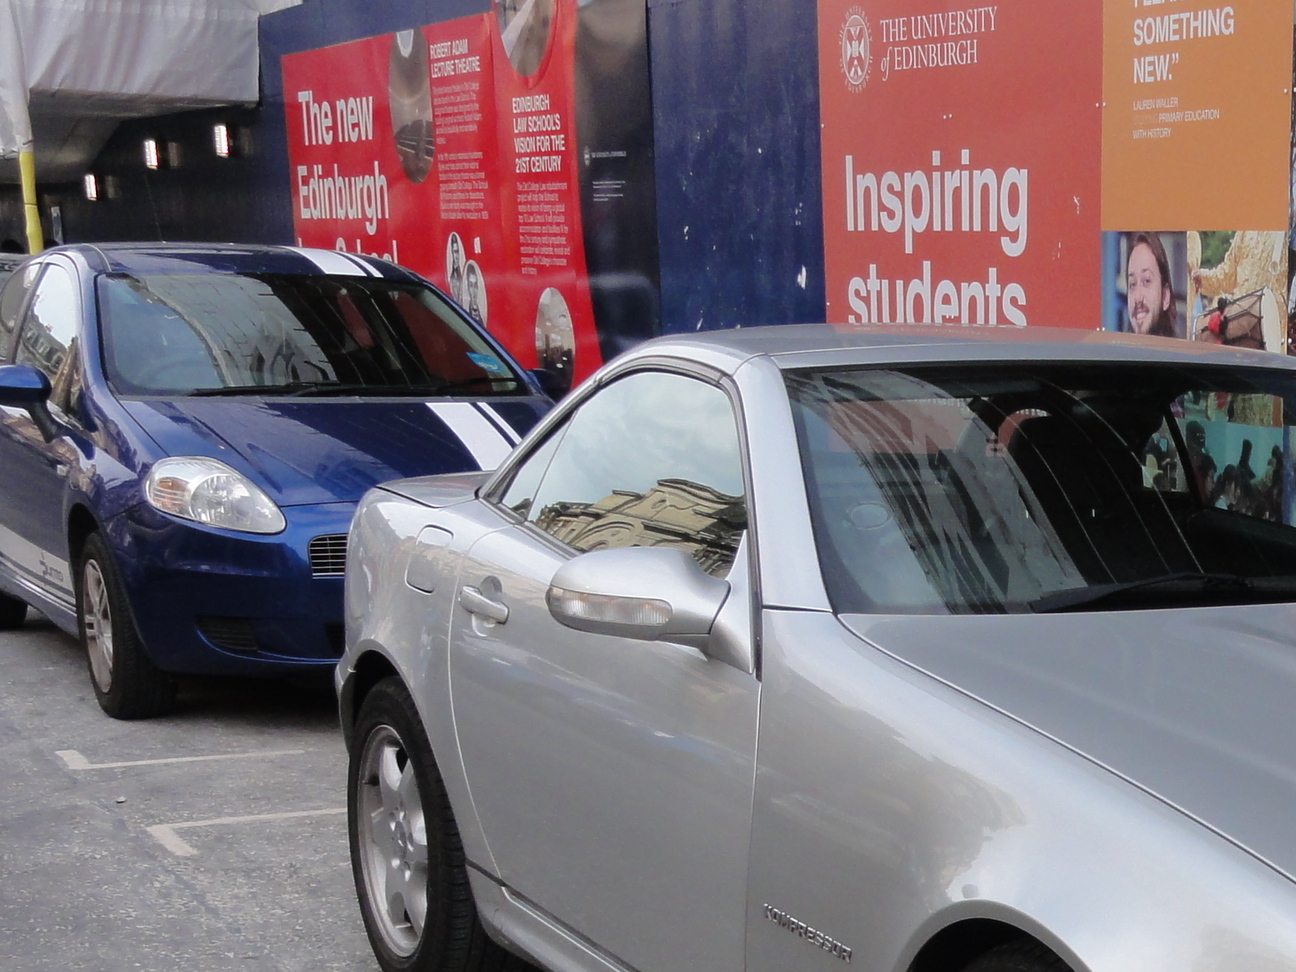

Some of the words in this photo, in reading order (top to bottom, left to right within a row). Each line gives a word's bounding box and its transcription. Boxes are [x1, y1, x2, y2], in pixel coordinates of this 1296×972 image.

[880, 17, 908, 43] THE
[911, 6, 998, 40] UNIVERSITY
[1133, 6, 1235, 46] SOMETHING
[430, 41, 451, 60] ROBERT
[452, 38, 468, 56] ADAM
[881, 46, 893, 82] of
[894, 39, 978, 71] EDINBURGH
[431, 60, 455, 78] LECTURE
[455, 56, 481, 75] THEATRE
[1133, 52, 1179, 84] NEW.”
[512, 94, 550, 113] EDINBURGH
[1133, 99, 1155, 111] LAUREN
[1155, 97, 1179, 109] WALLER
[1159, 111, 1184, 123] PRIMARY
[1184, 109, 1220, 122] EDUCATION
[297, 90, 333, 146] The
[336, 96, 373, 143] new
[513, 117, 528, 133] LAW
[513, 135, 536, 153] VISION
[536, 134, 551, 152] FOR
[550, 134, 566, 151] THE
[515, 157, 530, 173] 21ST
[530, 155, 562, 172] CENTURY
[297, 161, 389, 235] Edinburgh
[845, 149, 1028, 257] Inspiring
[848, 260, 1028, 327] students
